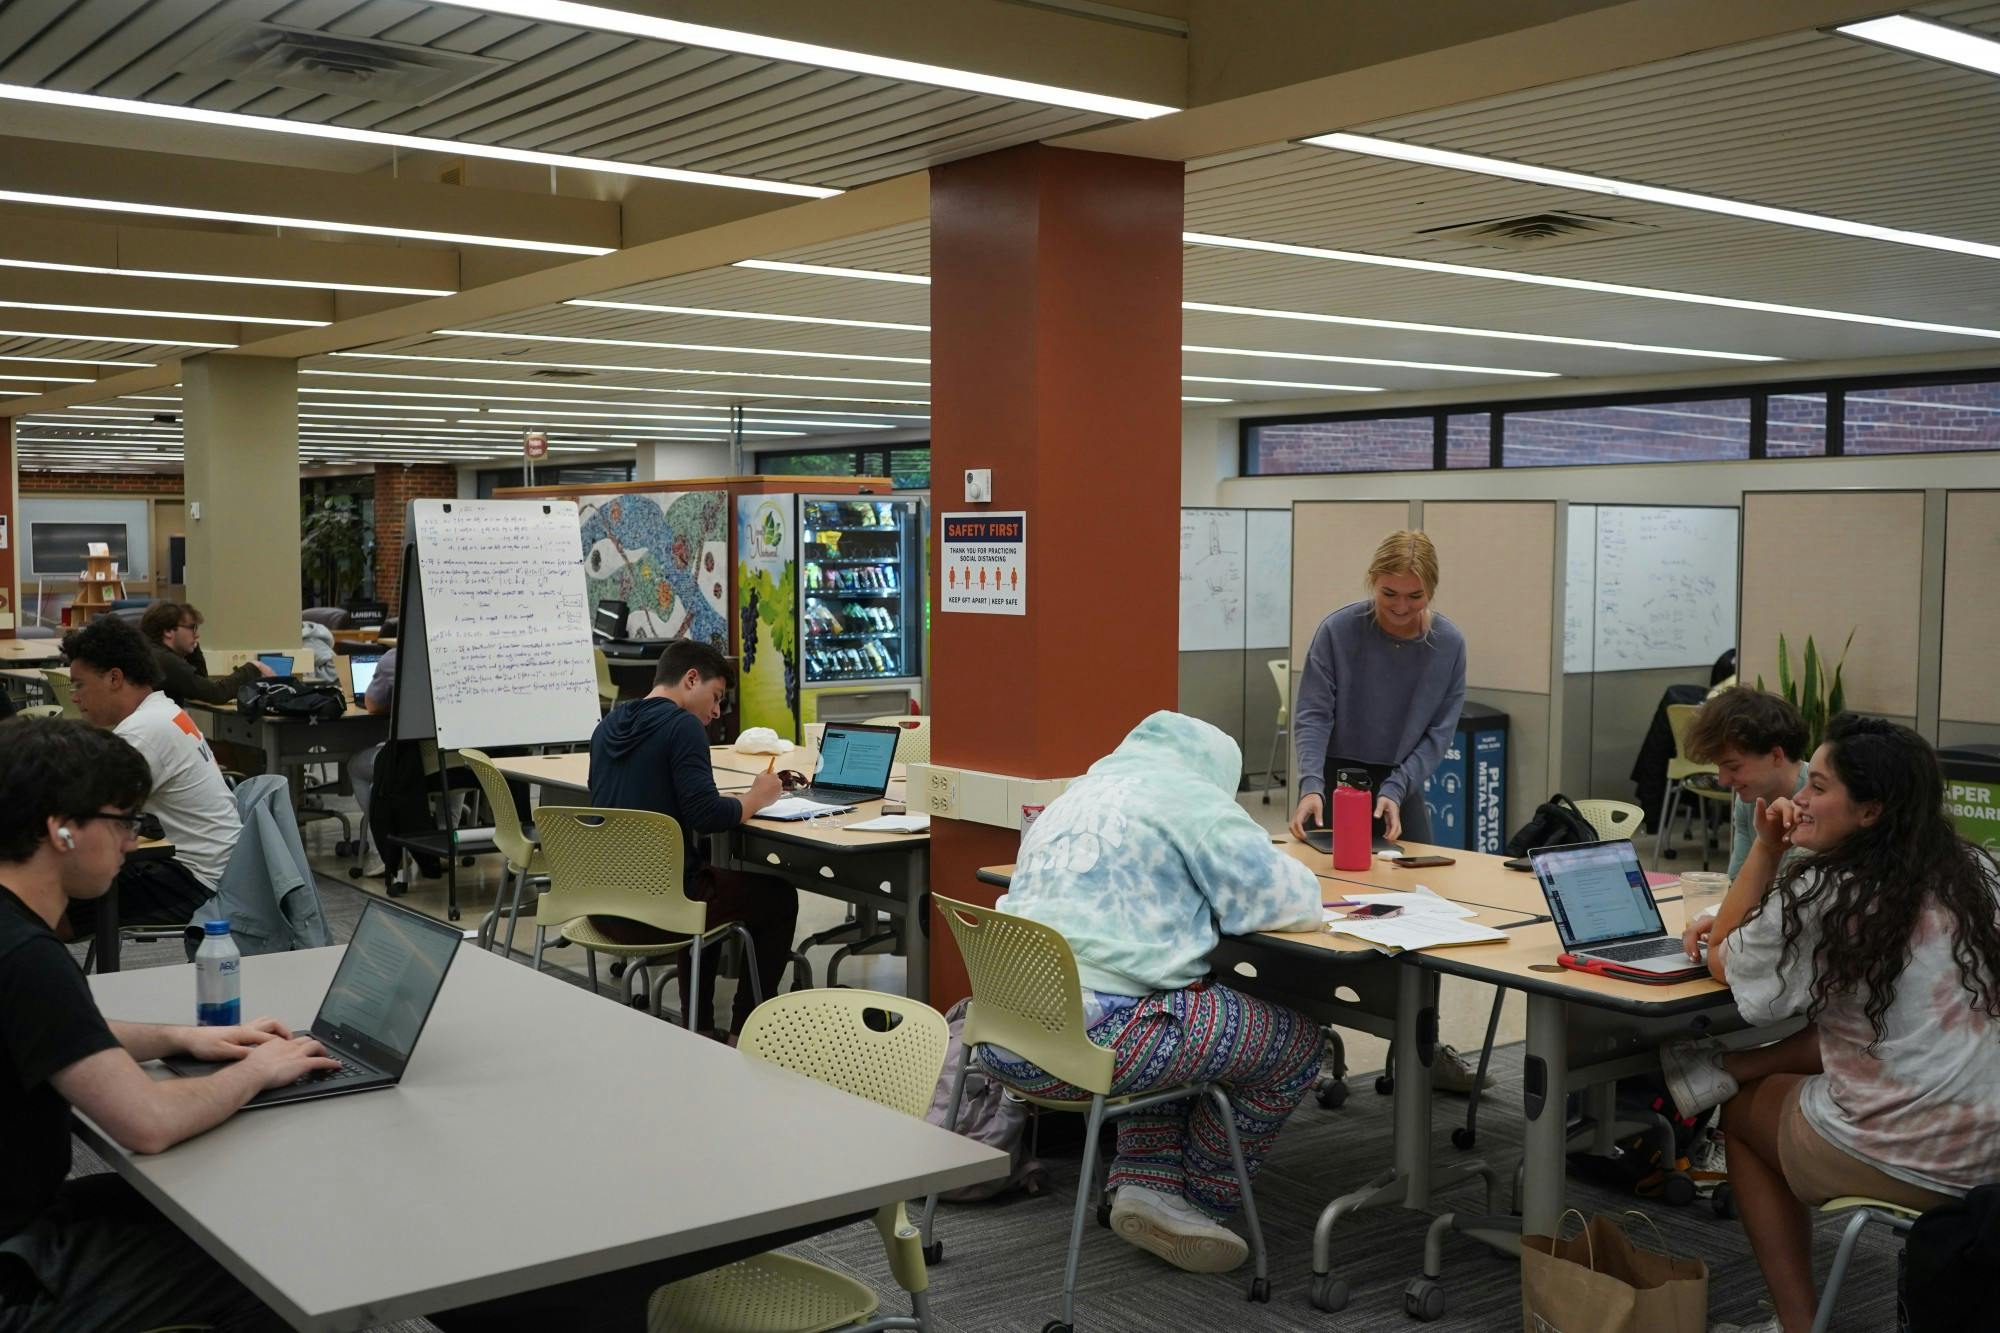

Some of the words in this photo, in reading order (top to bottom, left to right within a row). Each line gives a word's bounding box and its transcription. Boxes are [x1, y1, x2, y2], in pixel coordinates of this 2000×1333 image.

[948, 524, 985, 537] SAFETY
[989, 523, 1019, 537] FIRST
[1005, 598, 1018, 606] SAFE
[1478, 761, 1488, 813] METAL
[1487, 767, 1500, 852] PLASTIC
